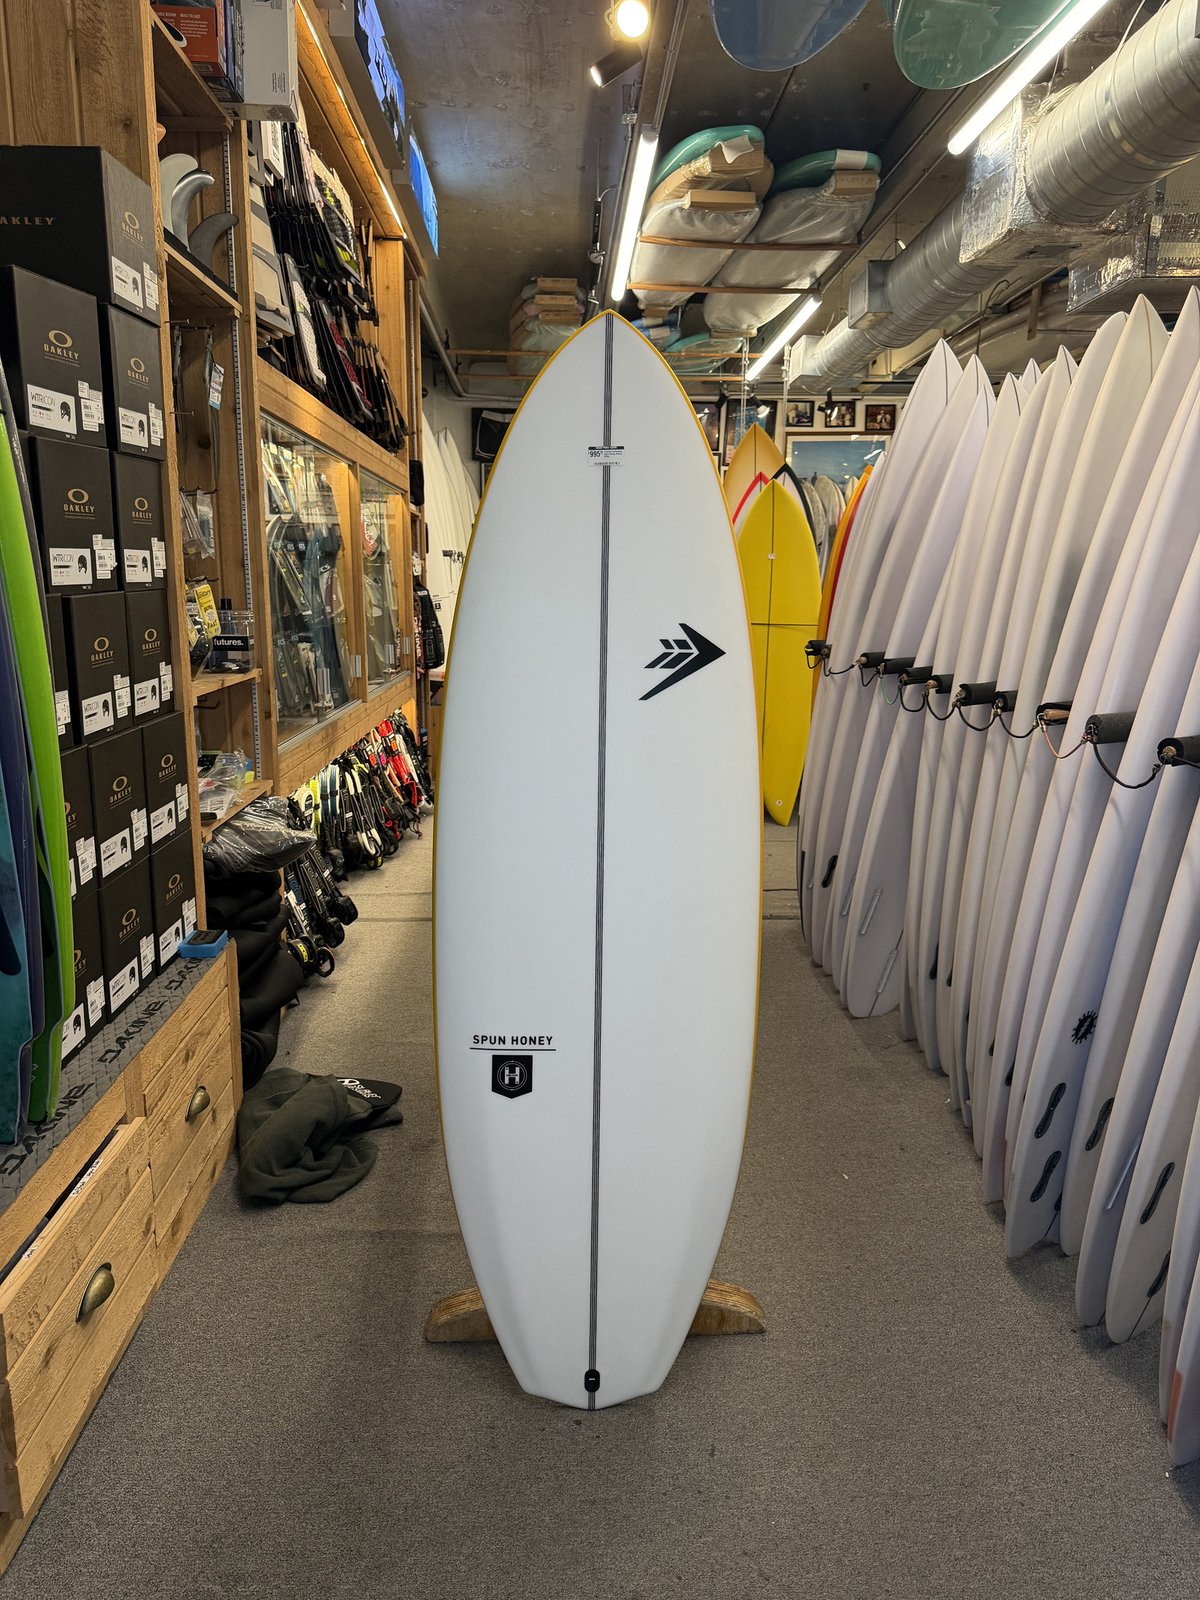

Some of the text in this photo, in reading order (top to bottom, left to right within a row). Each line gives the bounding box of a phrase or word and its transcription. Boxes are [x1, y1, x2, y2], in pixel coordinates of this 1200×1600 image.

[0, 216, 55, 225] AKLEY
[122, 222, 144, 242] OAKLEY
[43, 343, 79, 360] OAKLEY
[127, 370, 149, 383] OAKLEY
[63, 504, 95, 513] OAKLEY
[131, 511, 153, 519] OAKLEY
[142, 641, 160, 650] OAKLEY
[213, 638, 244, 646] futures.
[90, 650, 114, 661] OAKLEY
[158, 763, 177, 777] OAKLEY
[109, 786, 132, 802] OAKLEY
[165, 882, 184, 900] OAKLEY
[119, 916, 141, 938] OAKLEY
[473, 1035, 553, 1045] SPUN HONEY
